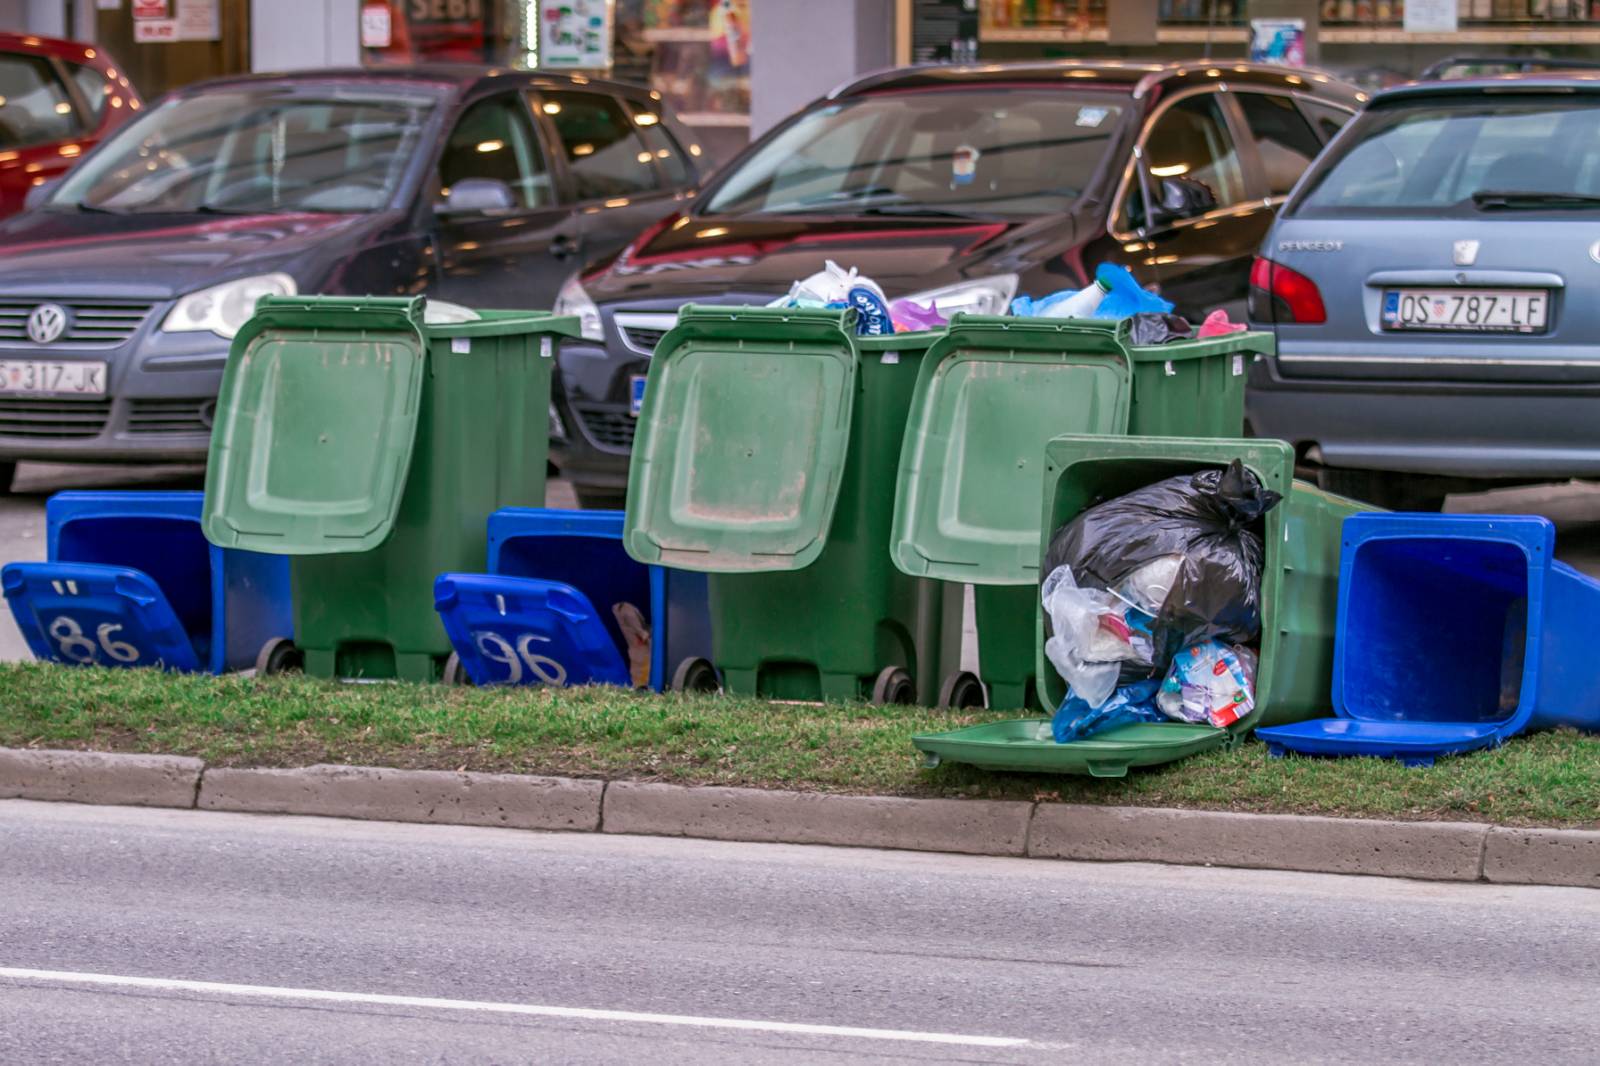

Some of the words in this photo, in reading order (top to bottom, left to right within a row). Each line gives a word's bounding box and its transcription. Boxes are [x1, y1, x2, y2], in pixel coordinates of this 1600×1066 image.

[1279, 239, 1344, 252] PEUGEOT
[49, 616, 140, 664] 86
[475, 631, 568, 686] 96
